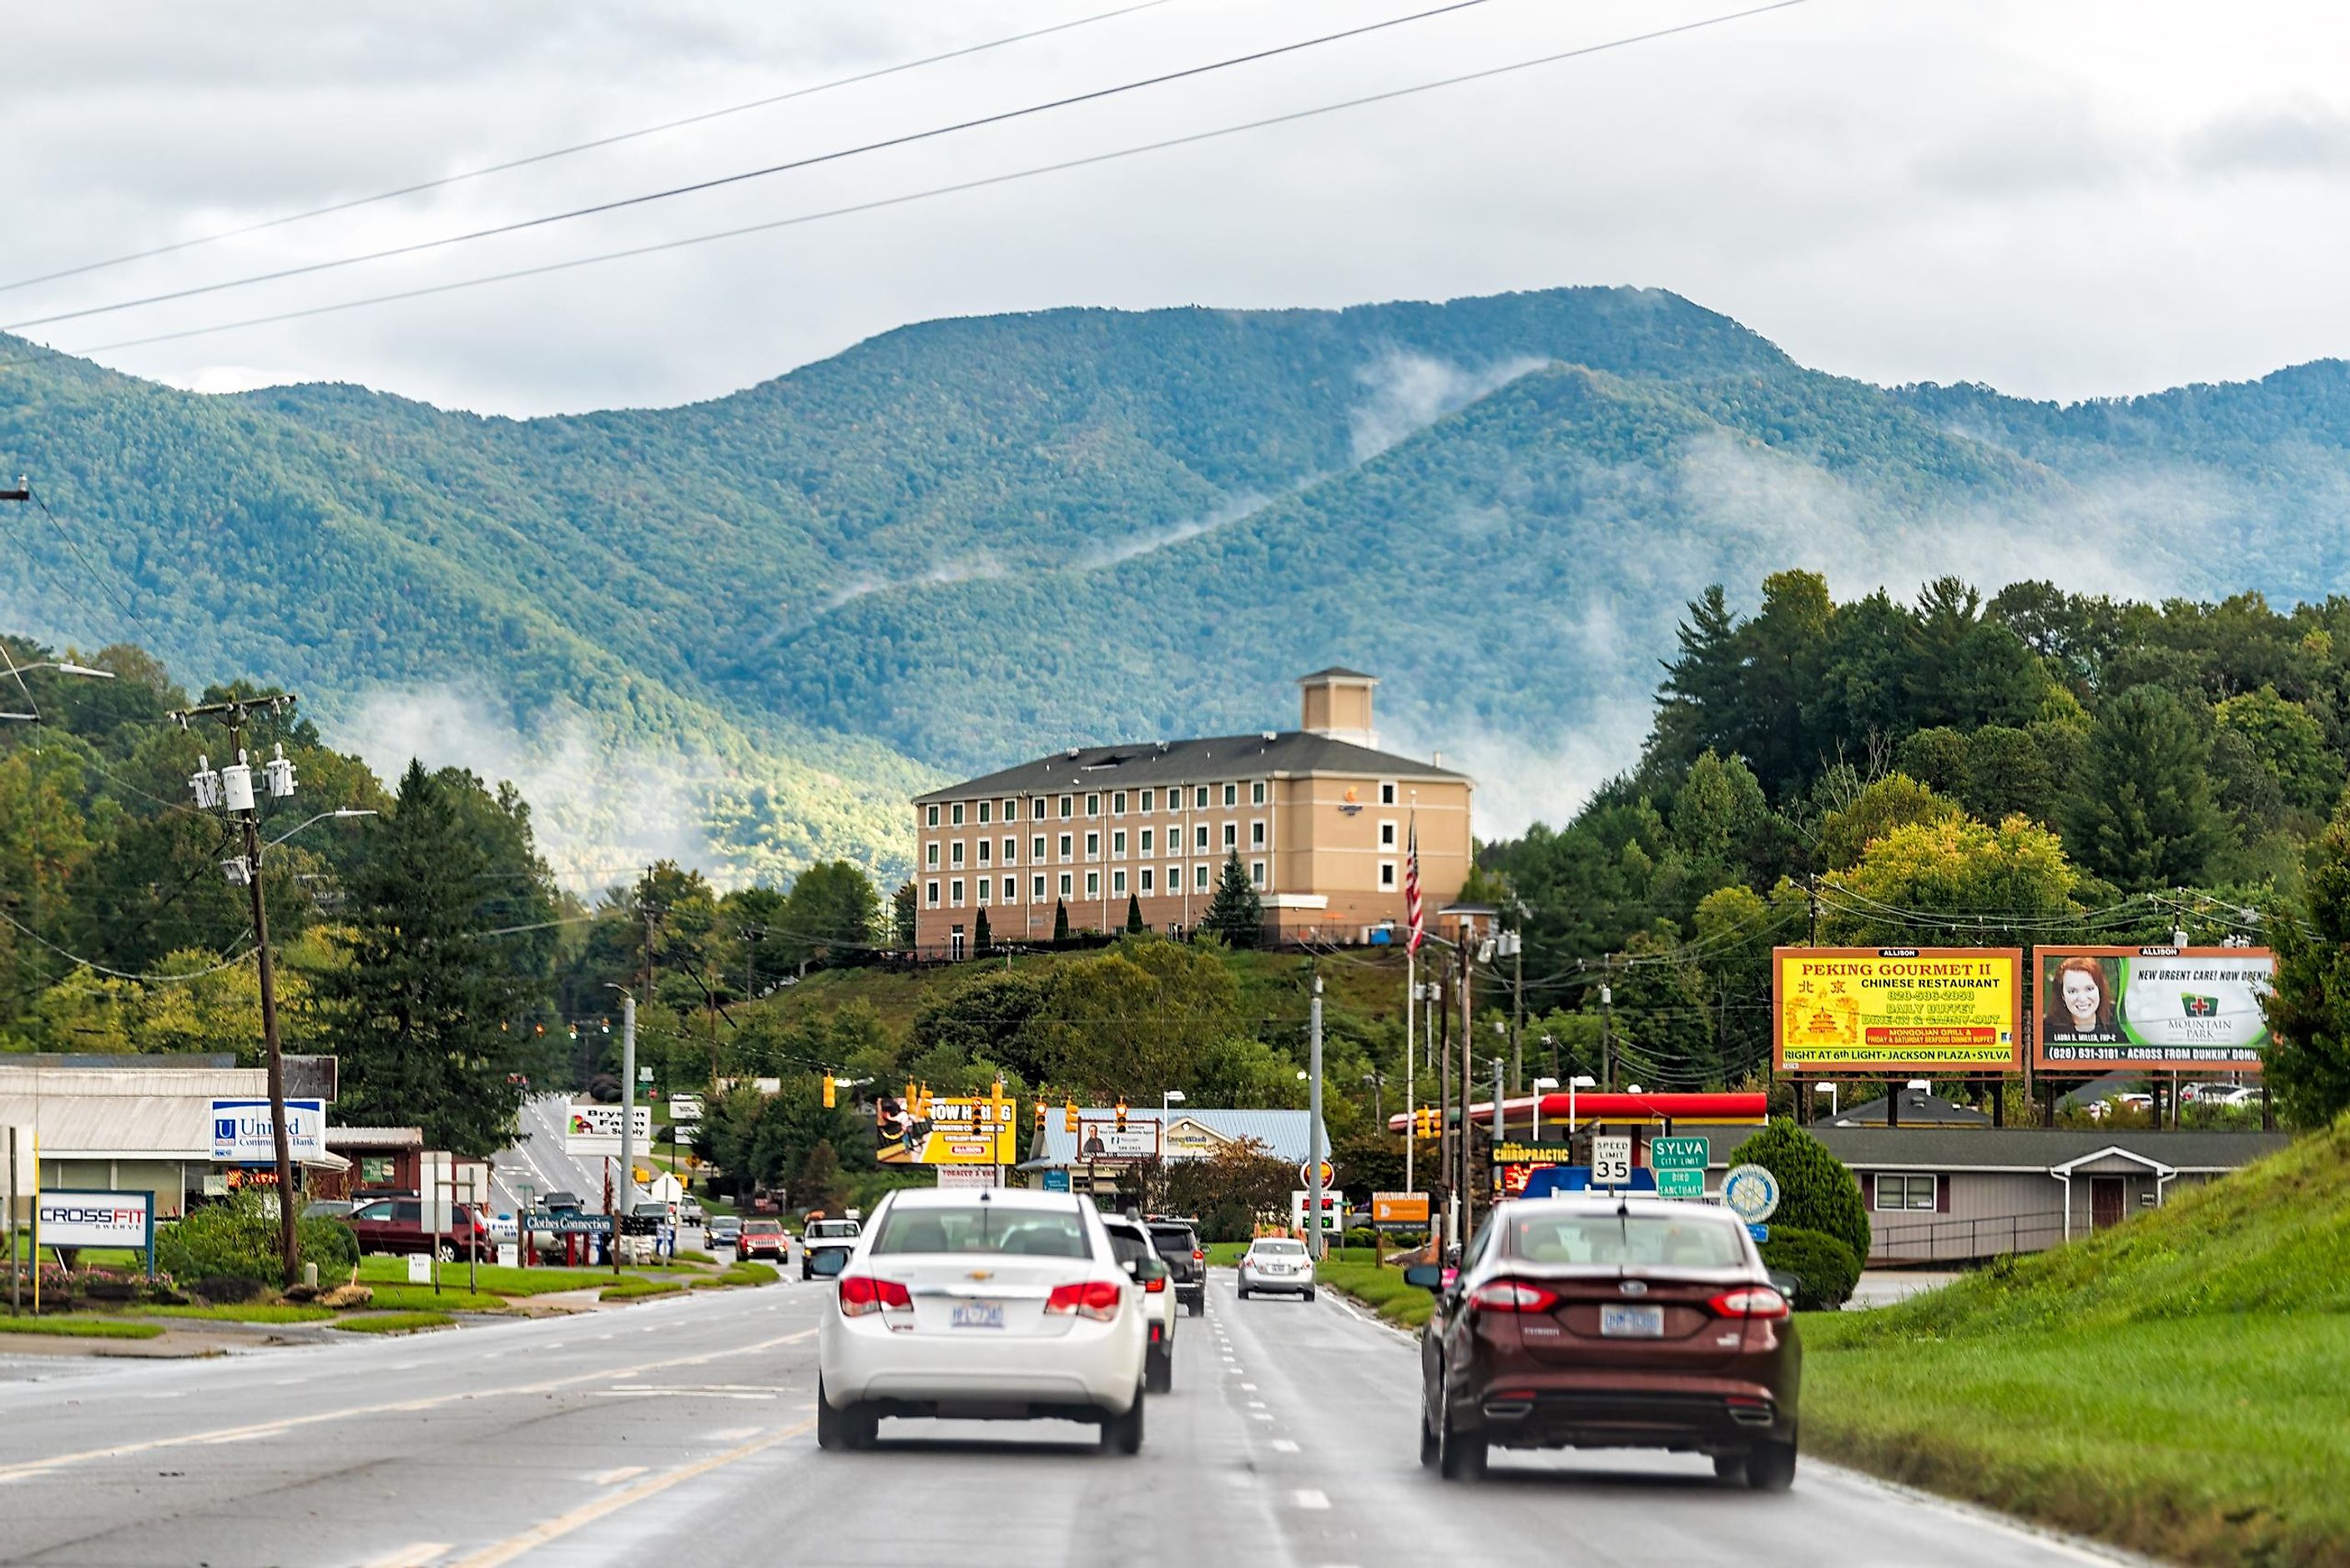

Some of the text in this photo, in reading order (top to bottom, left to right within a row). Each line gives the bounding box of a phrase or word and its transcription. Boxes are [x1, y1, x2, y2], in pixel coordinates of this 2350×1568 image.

[1803, 964, 1991, 976] PEKING GOURMET II
[2138, 970, 2157, 981] NEW
[2159, 970, 2191, 981] URGENT
[2193, 970, 2218, 981] CARE!
[2220, 971, 2242, 981] NOW
[1861, 979, 2000, 988] CHINESE RESTAURANT
[1886, 1004, 1975, 1014] DAILY BUFFET
[1862, 1014, 1910, 1025] DINE-IN
[1926, 1014, 2000, 1025] CARRY-OUT
[2169, 1020, 2231, 1029] MOUNTAIN
[1894, 1036, 1924, 1044] SATURDAY
[2186, 1030, 2215, 1039] PARK
[1785, 1051, 1815, 1060] RIGHT
[1818, 1051, 1833, 1060] AT
[1833, 1051, 1849, 1061] 6th
[1887, 1051, 1935, 1060] JACKSON
[1937, 1051, 1973, 1060] PLAZA
[1977, 1051, 2010, 1060] SYLVA
[2049, 1046, 2076, 1060] (828)
[2127, 1047, 2163, 1060] ACROSS
[2165, 1048, 2191, 1060] FROM
[2193, 1048, 2231, 1060] DUNKIN'
[2232, 1048, 2261, 1060] DONU
[961, 1105, 1011, 1122] HRIG
[241, 1117, 299, 1135] Unid
[612, 1127, 645, 1137] Suly
[292, 1137, 315, 1147] Bank
[1596, 1142, 1629, 1150] SPEED
[1657, 1142, 1704, 1155] SYLVA
[1493, 1148, 1569, 1162] CHIROPRACTIC
[1596, 1161, 1628, 1178] 35
[1672, 1172, 1690, 1182] BIRD
[1658, 1185, 1702, 1196] SANCTUARY
[41, 1208, 147, 1223] CROSSFIT
[527, 1216, 611, 1230] Clothes Connection
